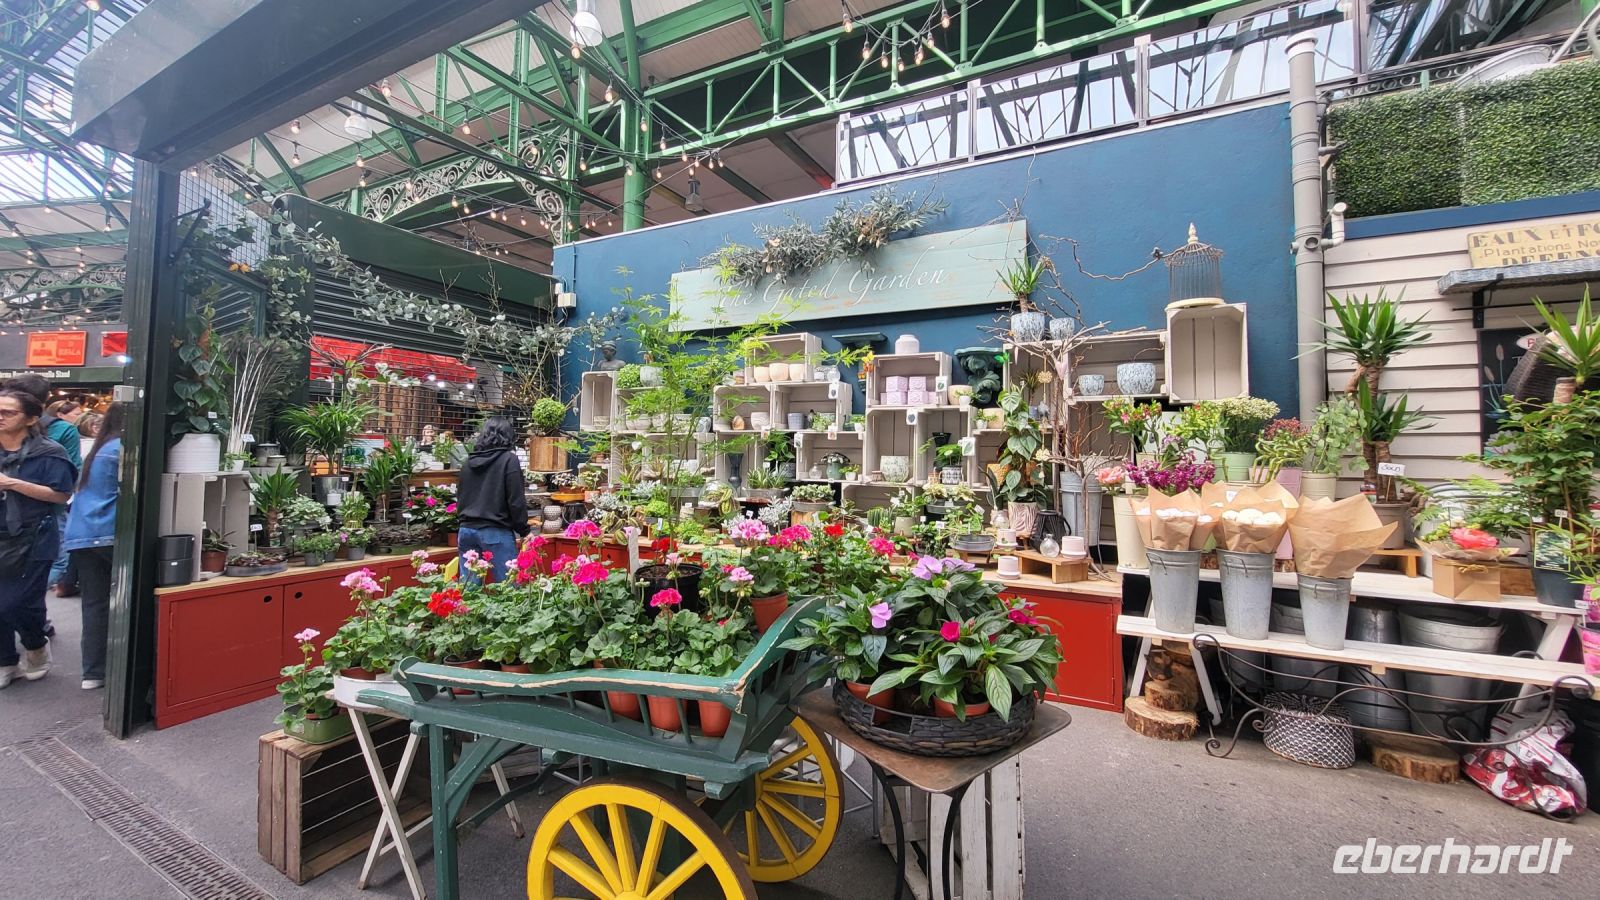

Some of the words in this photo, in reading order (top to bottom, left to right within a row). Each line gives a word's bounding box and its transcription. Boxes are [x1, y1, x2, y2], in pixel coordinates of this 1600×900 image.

[1473, 230, 1543, 248] EAUX
[1484, 242, 1572, 258] Plantations
[762, 258, 851, 314] Gated
[848, 246, 946, 306] Garden
